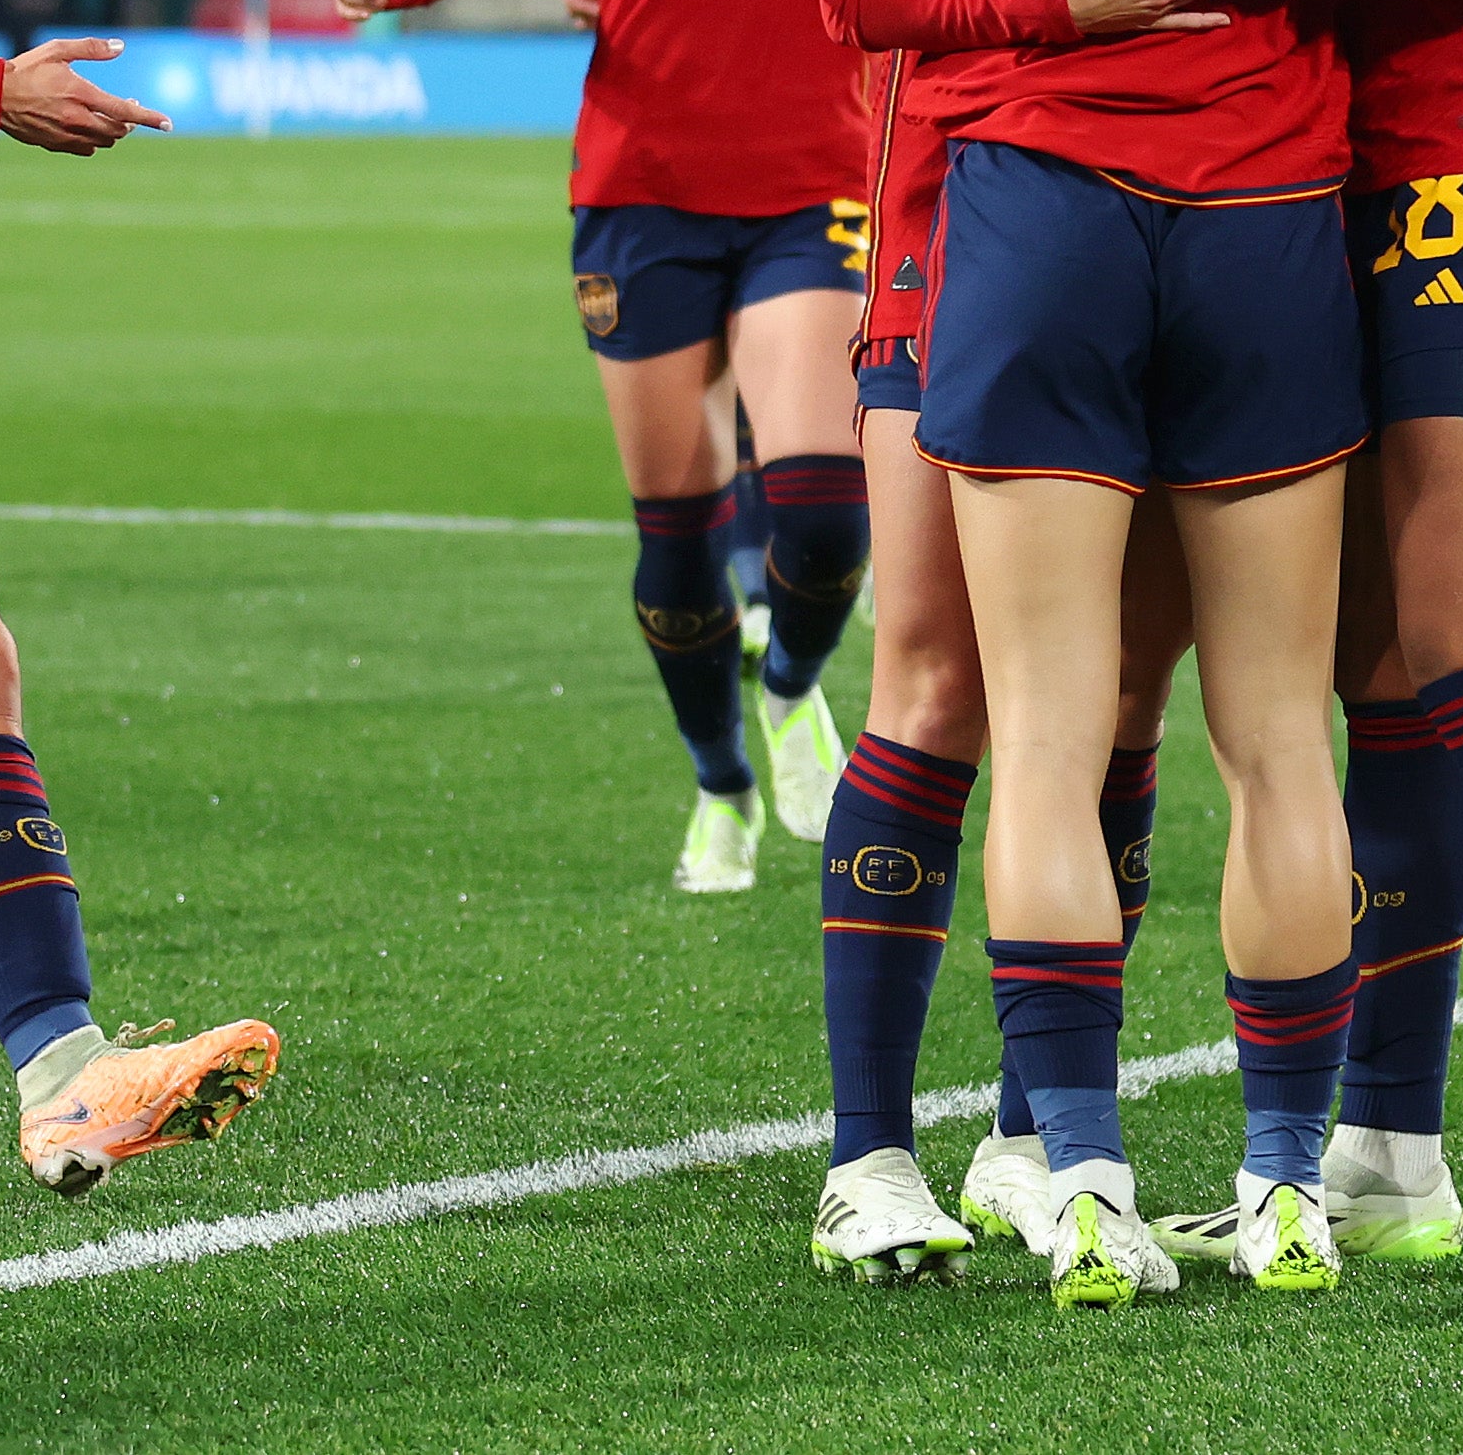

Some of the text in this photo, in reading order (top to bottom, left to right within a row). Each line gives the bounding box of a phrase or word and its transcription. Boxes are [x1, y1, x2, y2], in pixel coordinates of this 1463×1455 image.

[829, 858, 849, 874] 19
[926, 871, 947, 886] 09
[1372, 890, 1406, 908] 09
